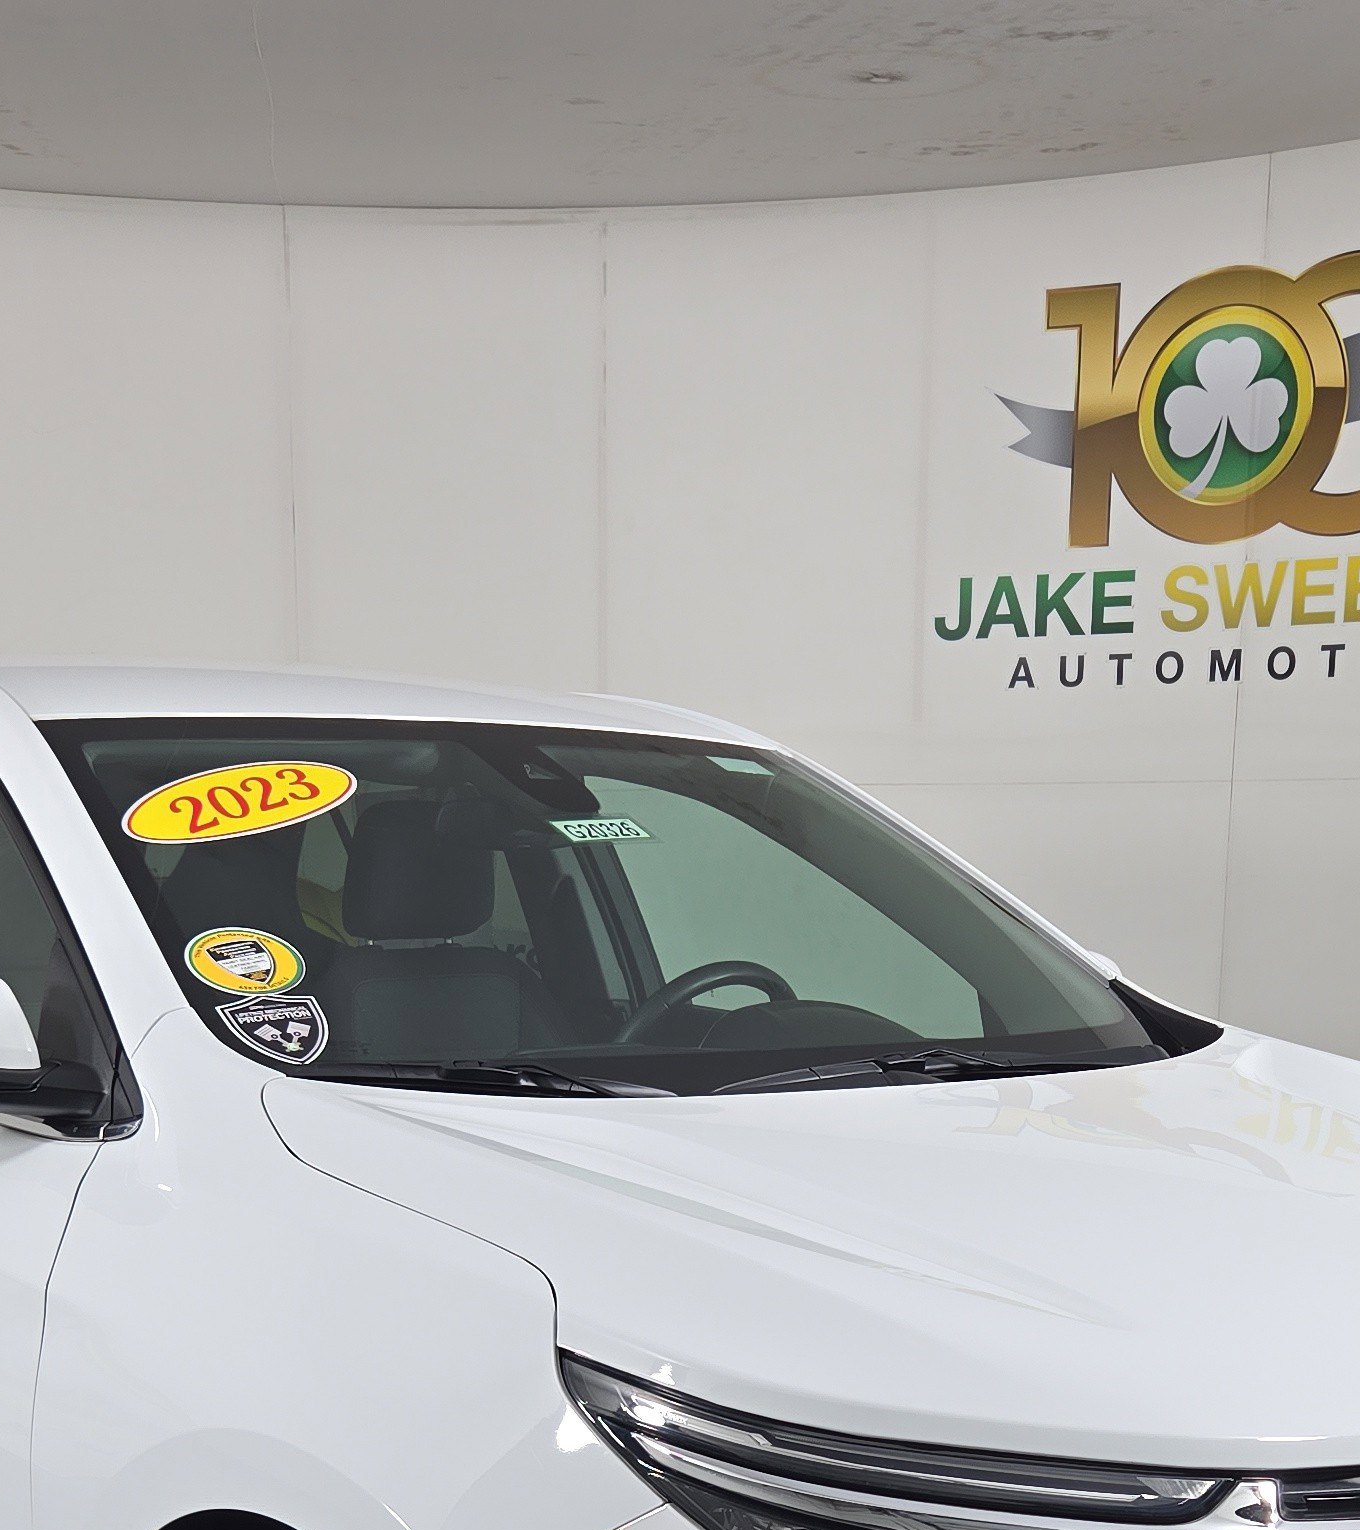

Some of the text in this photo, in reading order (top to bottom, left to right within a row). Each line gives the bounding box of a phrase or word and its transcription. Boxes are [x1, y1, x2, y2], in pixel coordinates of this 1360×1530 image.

[934, 570, 1135, 641] JAKE
[170, 767, 320, 833] 2023
[563, 822, 641, 839] G20326
[237, 1009, 313, 1025] PROTECTION
